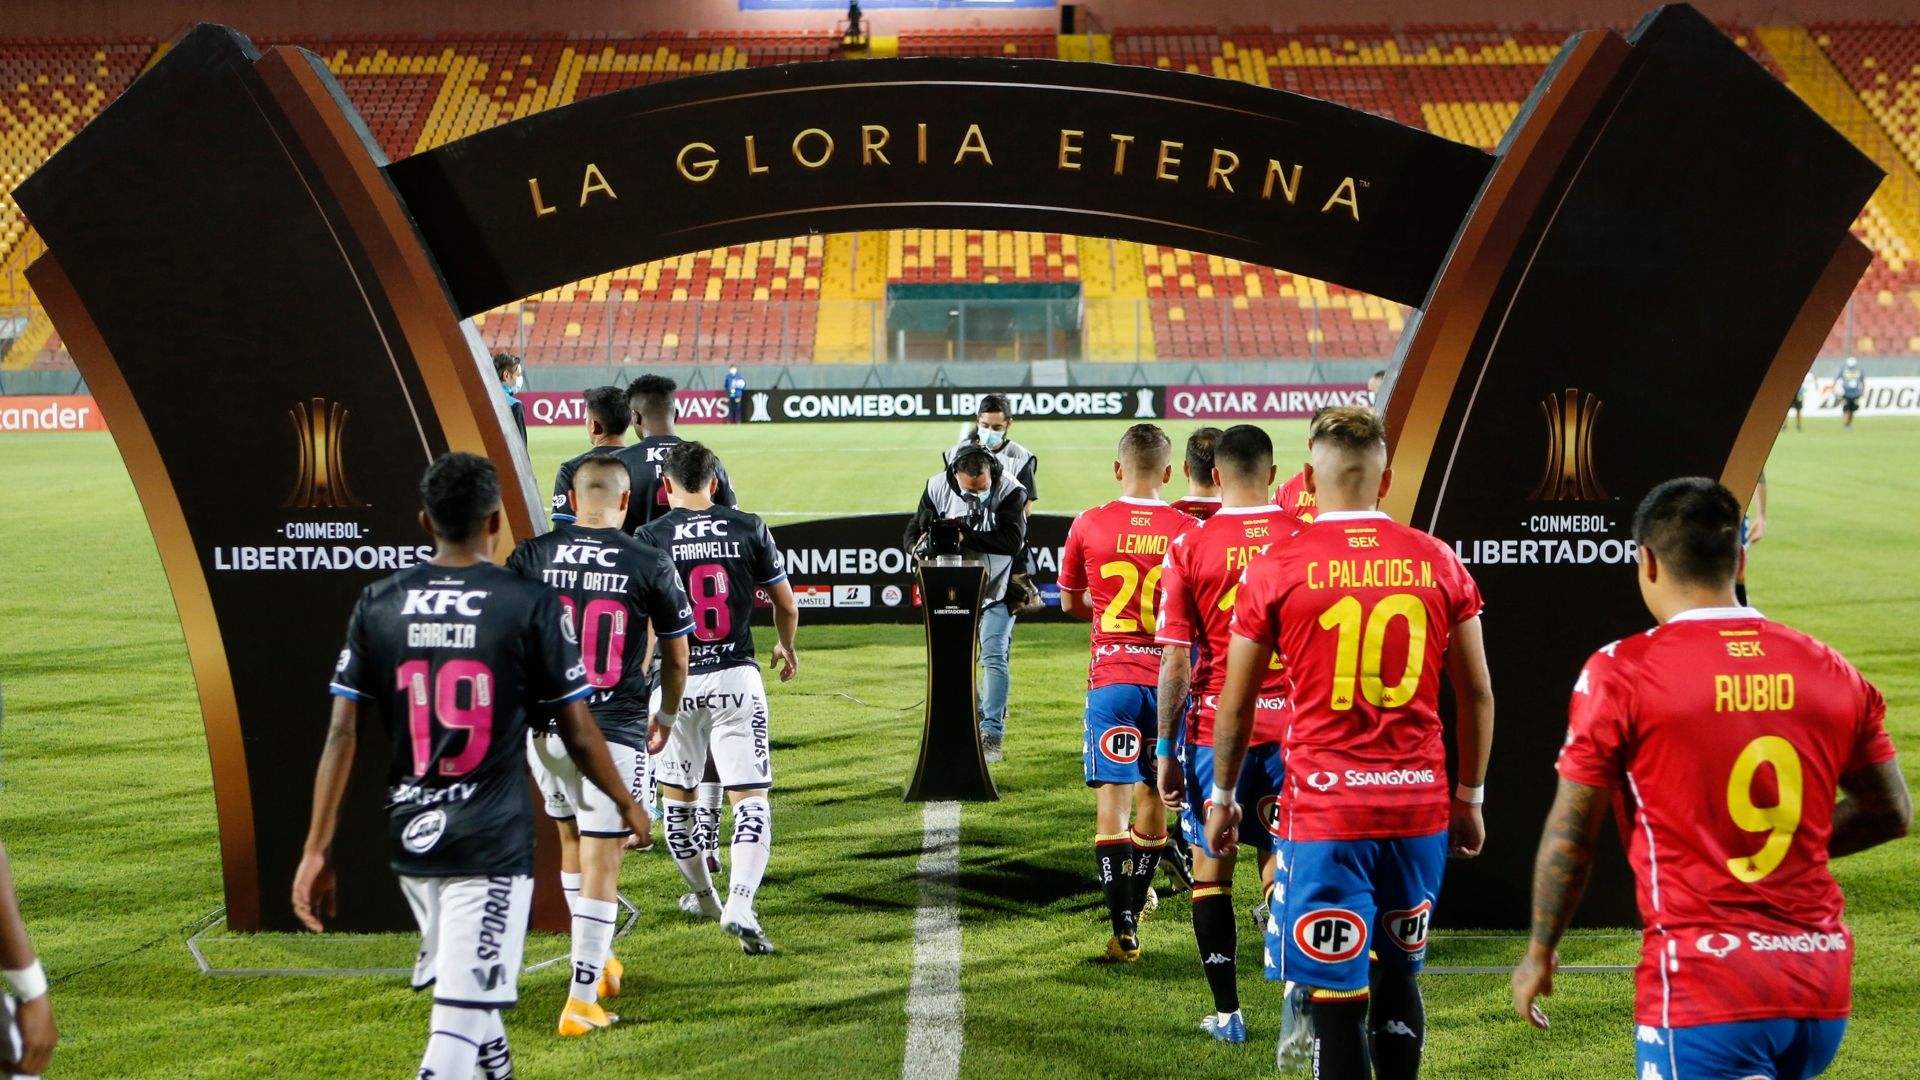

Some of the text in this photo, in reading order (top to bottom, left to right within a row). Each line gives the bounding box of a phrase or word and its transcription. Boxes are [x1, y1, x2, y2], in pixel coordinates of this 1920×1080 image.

[527, 162, 618, 219] LA
[675, 122, 994, 183] GLORIA
[1057, 128, 1361, 223] ETERNA
[532, 397, 730, 424] QAT WAYS
[783, 391, 1123, 418] CONMEBOL LIBTADORES
[1172, 389, 1368, 417] QATAR AIRWAYS
[672, 519, 729, 541] KFC
[1245, 526, 1270, 539] SEK
[1347, 536, 1380, 548] SEK
[213, 544, 434, 571] LIBERTADORES
[552, 544, 620, 568] KFC
[672, 541, 741, 562] FARAVELLI
[1116, 533, 1168, 556] LEMMO
[1455, 539, 1640, 565] LIBERTADOR
[778, 547, 917, 575] NMEBOL
[582, 571, 629, 594] ORTIZ
[400, 589, 488, 617] KFC
[688, 563, 732, 642] 8
[797, 598, 828, 606] AMSTEL
[407, 623, 477, 649] GARCIA
[1725, 640, 1766, 657] SEK
[1318, 593, 1428, 711] 10
[1714, 672, 1795, 713] RUBIO
[395, 658, 495, 777] 19
[1112, 733, 1137, 755] PF
[1726, 735, 1804, 884] 9
[666, 806, 698, 860] ROLAND
[1101, 856, 1113, 885] OCAR
[1312, 919, 1352, 953] PF
